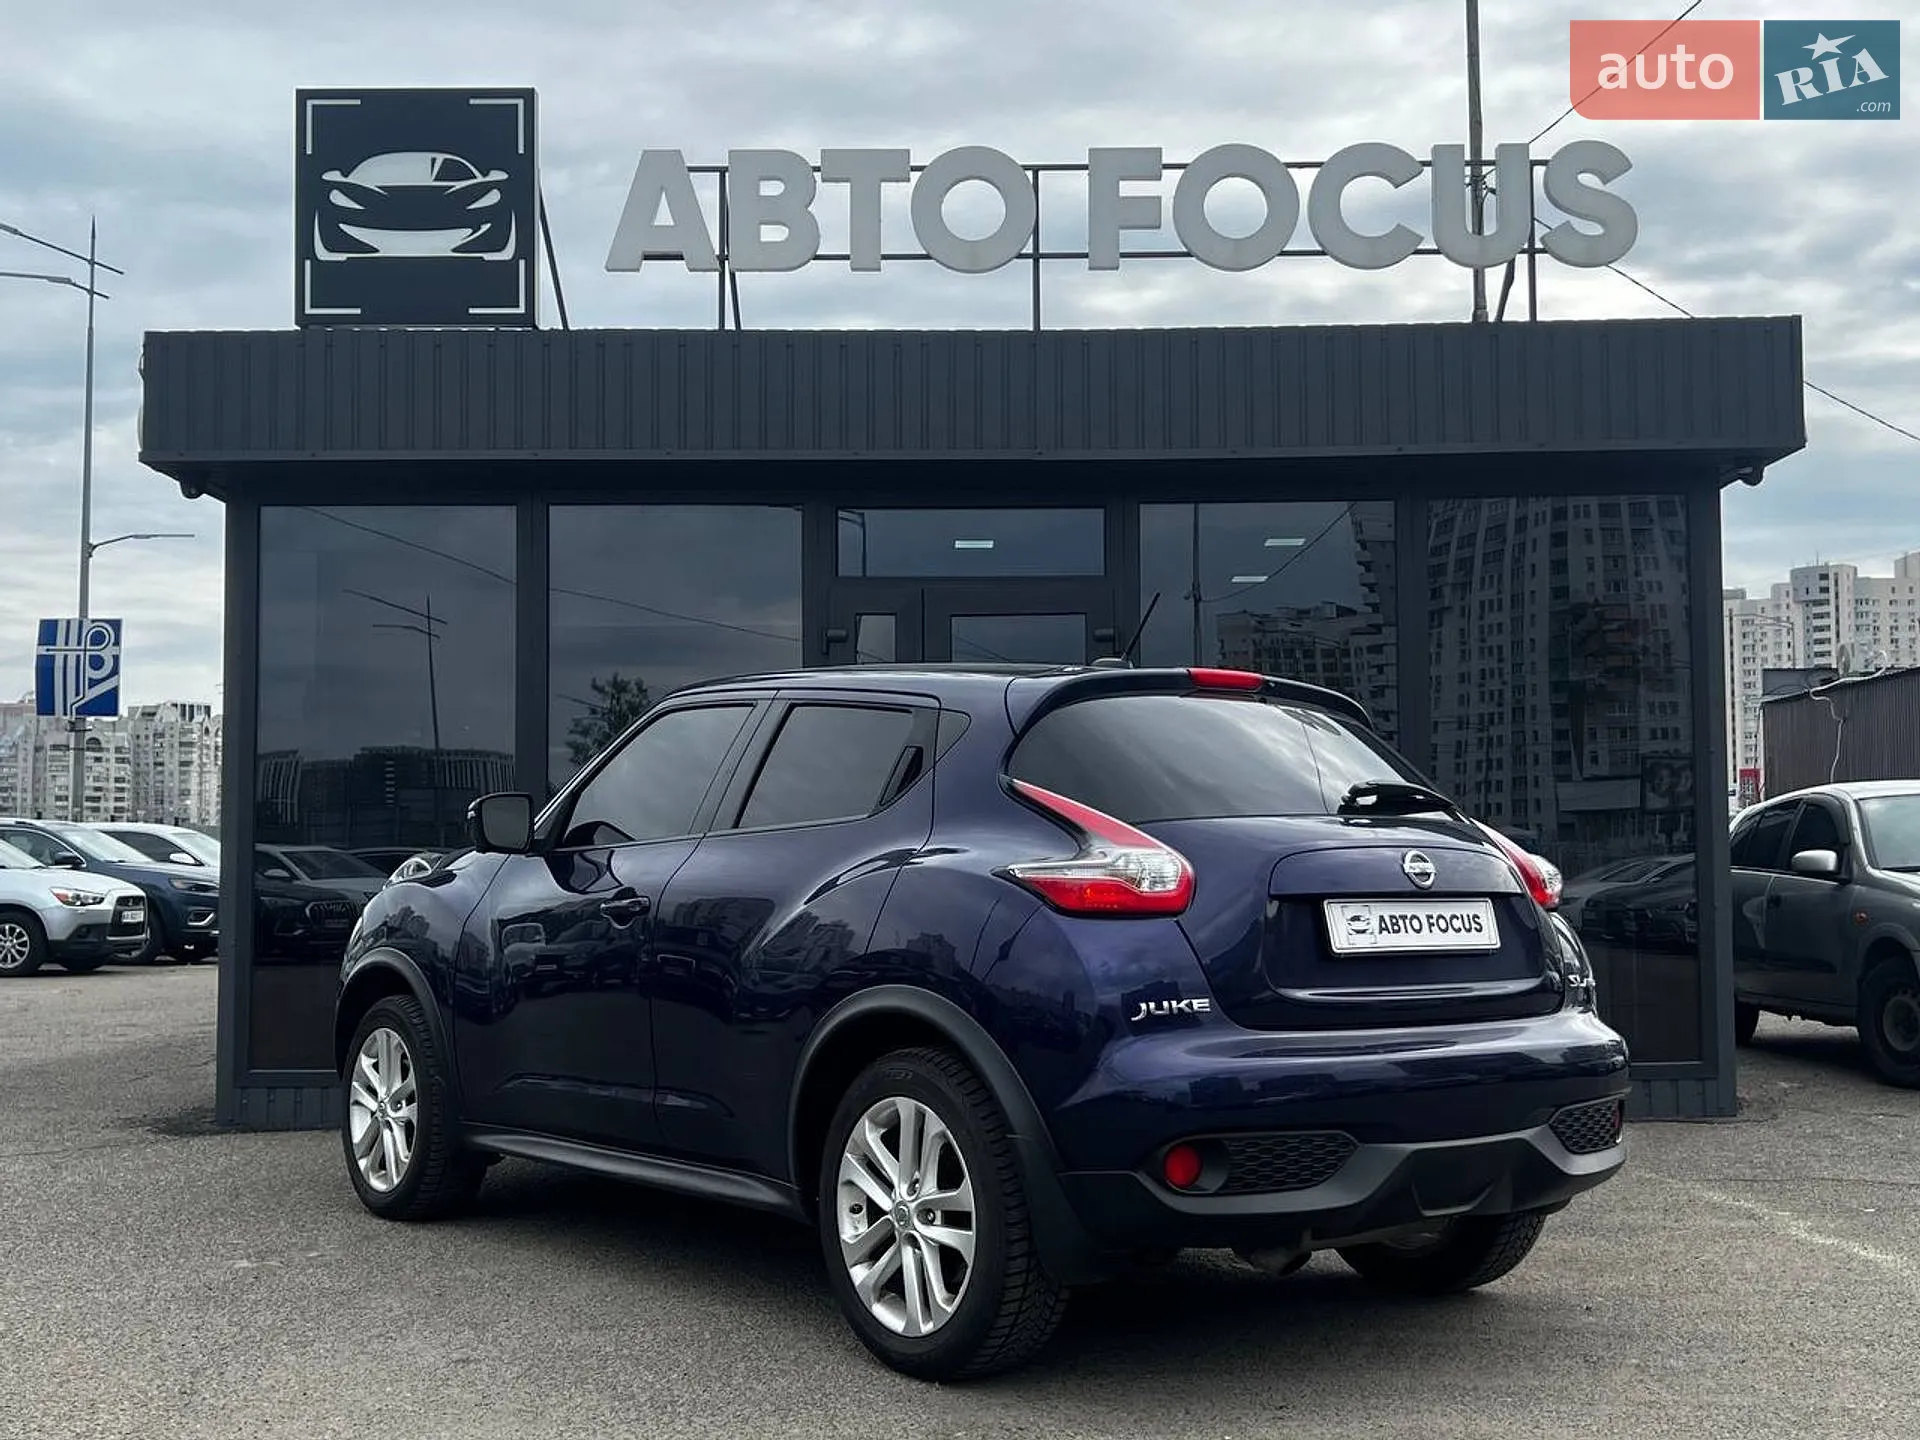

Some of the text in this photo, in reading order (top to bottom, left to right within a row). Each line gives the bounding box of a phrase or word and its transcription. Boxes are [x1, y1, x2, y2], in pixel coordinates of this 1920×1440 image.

[1088, 140, 1638, 272] FOCUS
[1425, 913, 1483, 934] FOCUS
[1130, 998, 1211, 1021] JUKE
